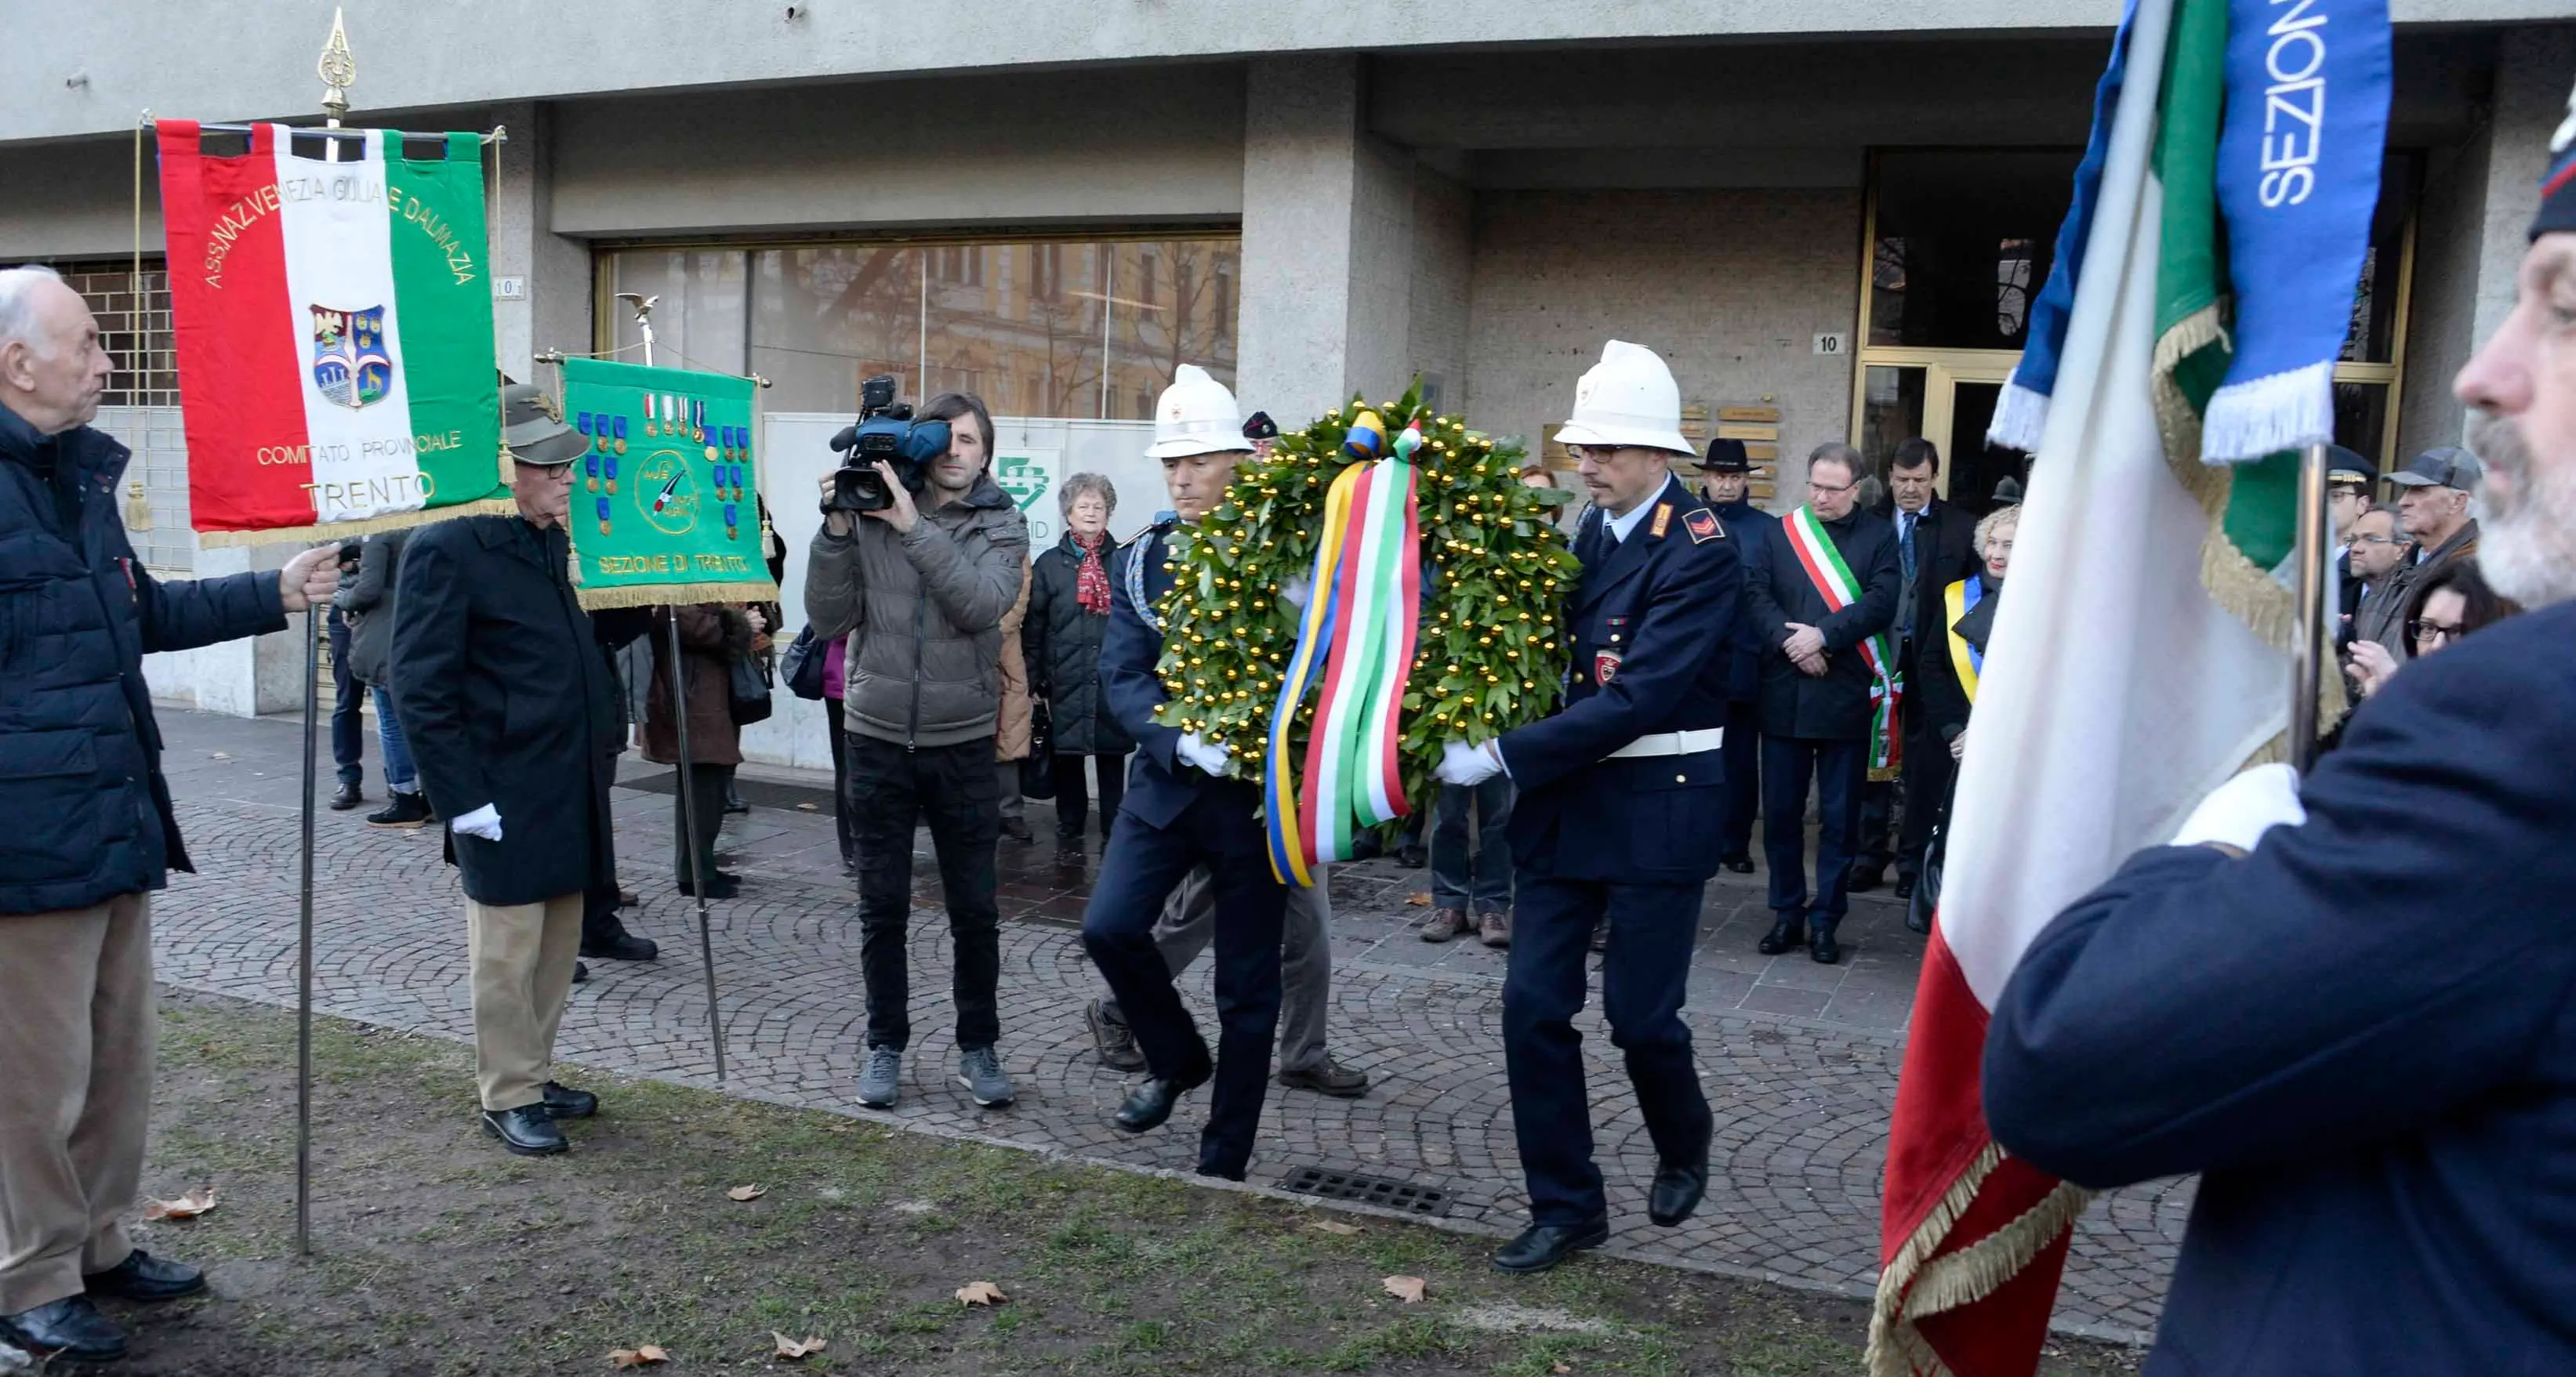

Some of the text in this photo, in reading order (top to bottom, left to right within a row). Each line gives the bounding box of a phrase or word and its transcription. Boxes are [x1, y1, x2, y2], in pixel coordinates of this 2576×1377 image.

[388, 187, 402, 212] E
[404, 197, 476, 285] DALMAZIA
[1821, 336, 1837, 352] 10
[256, 430, 463, 466] COMITATO PROVINCIALE
[299, 471, 436, 511] TRENTO
[599, 554, 749, 574] SEZIONE DI TRENTO
